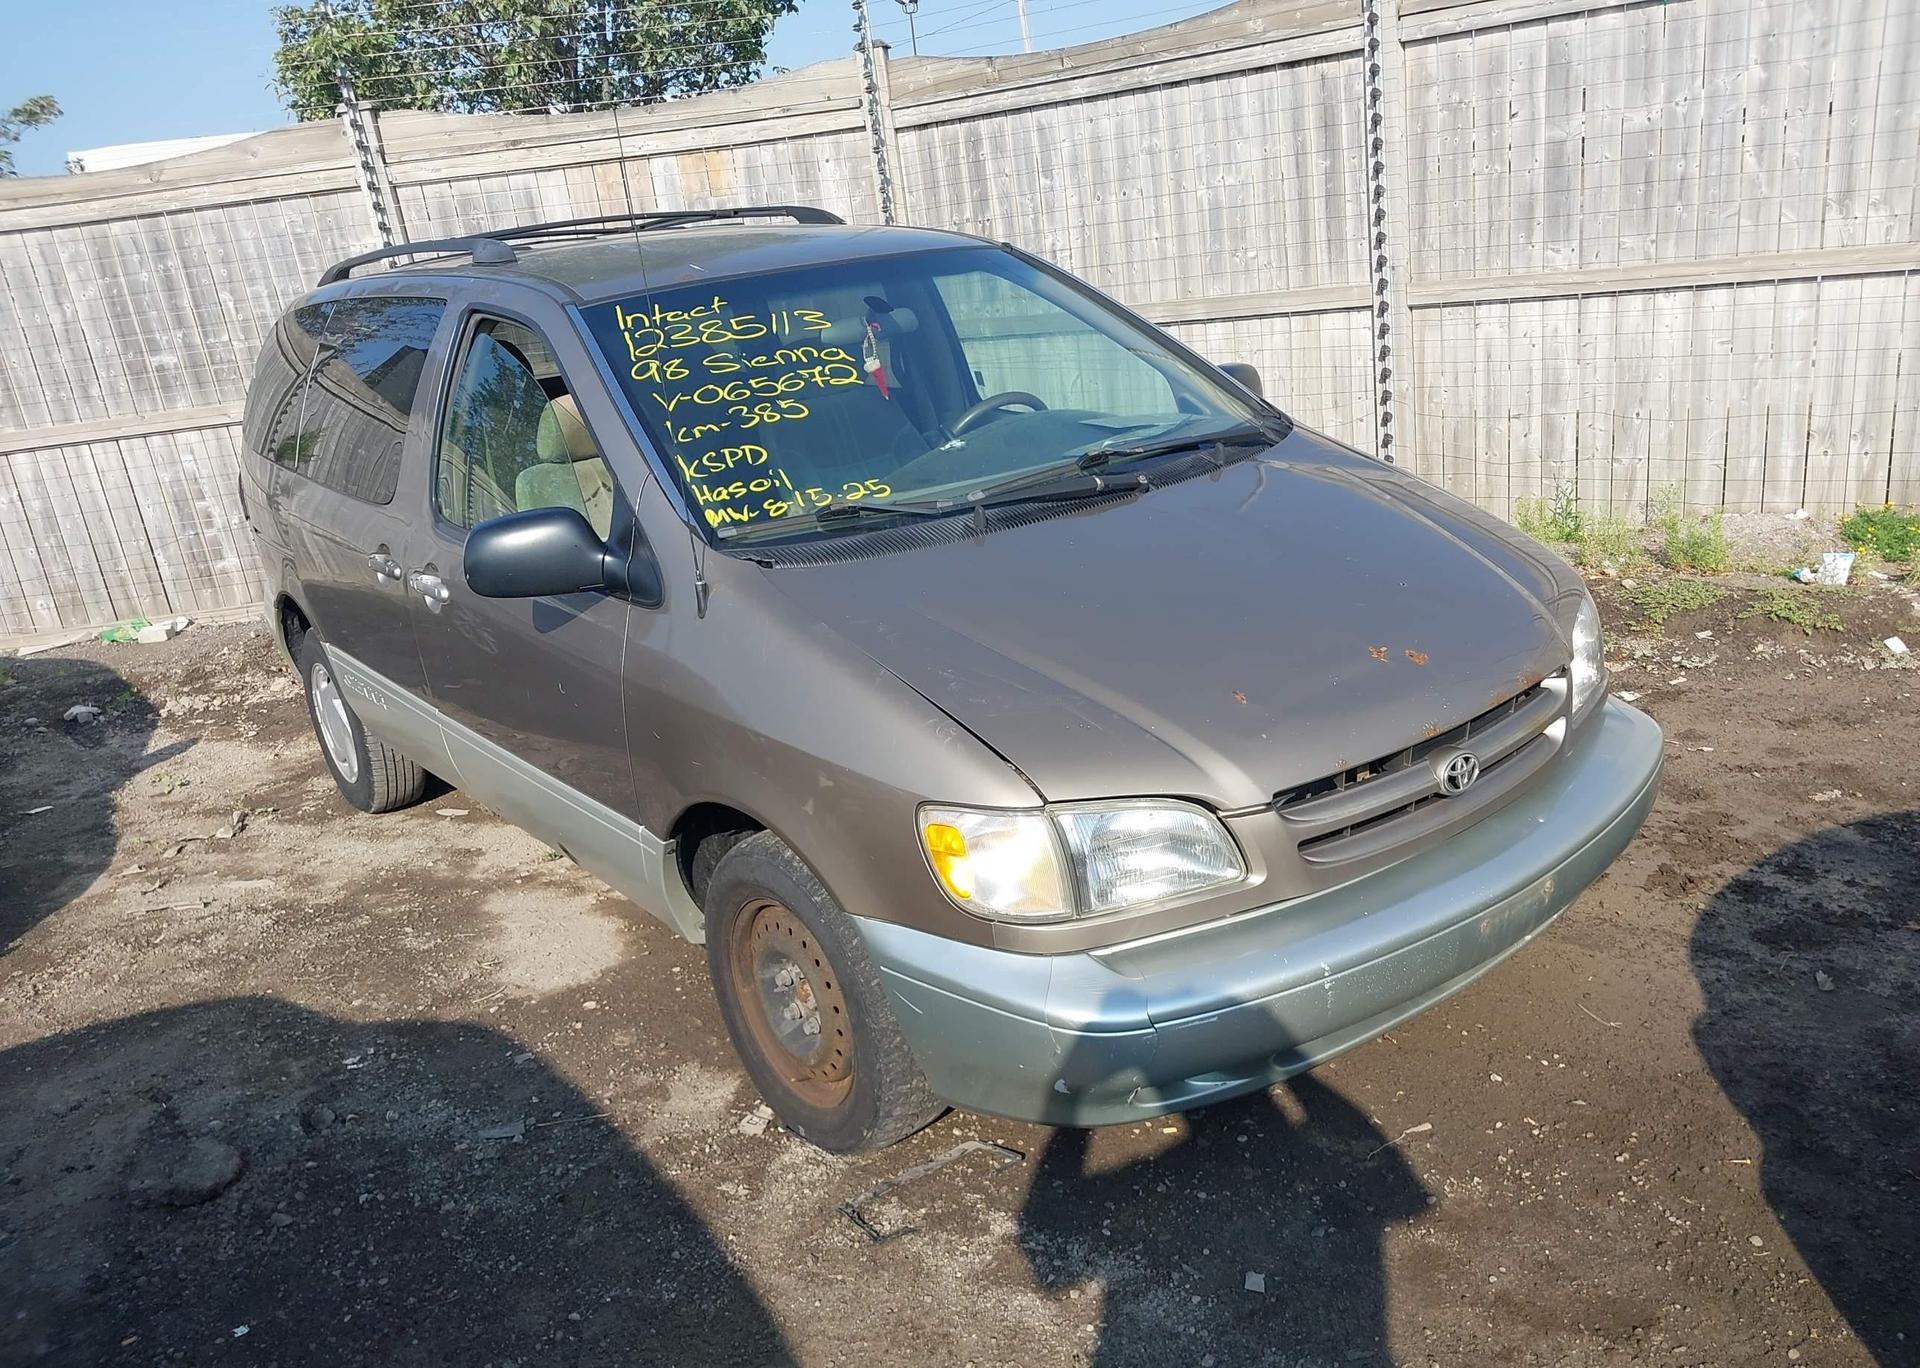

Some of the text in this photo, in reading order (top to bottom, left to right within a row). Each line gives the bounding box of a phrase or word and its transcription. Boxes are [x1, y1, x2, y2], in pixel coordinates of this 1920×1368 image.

[616, 296, 728, 330] Intact
[624, 310, 832, 361] 12385113
[631, 345, 857, 383] 98 Sienna
